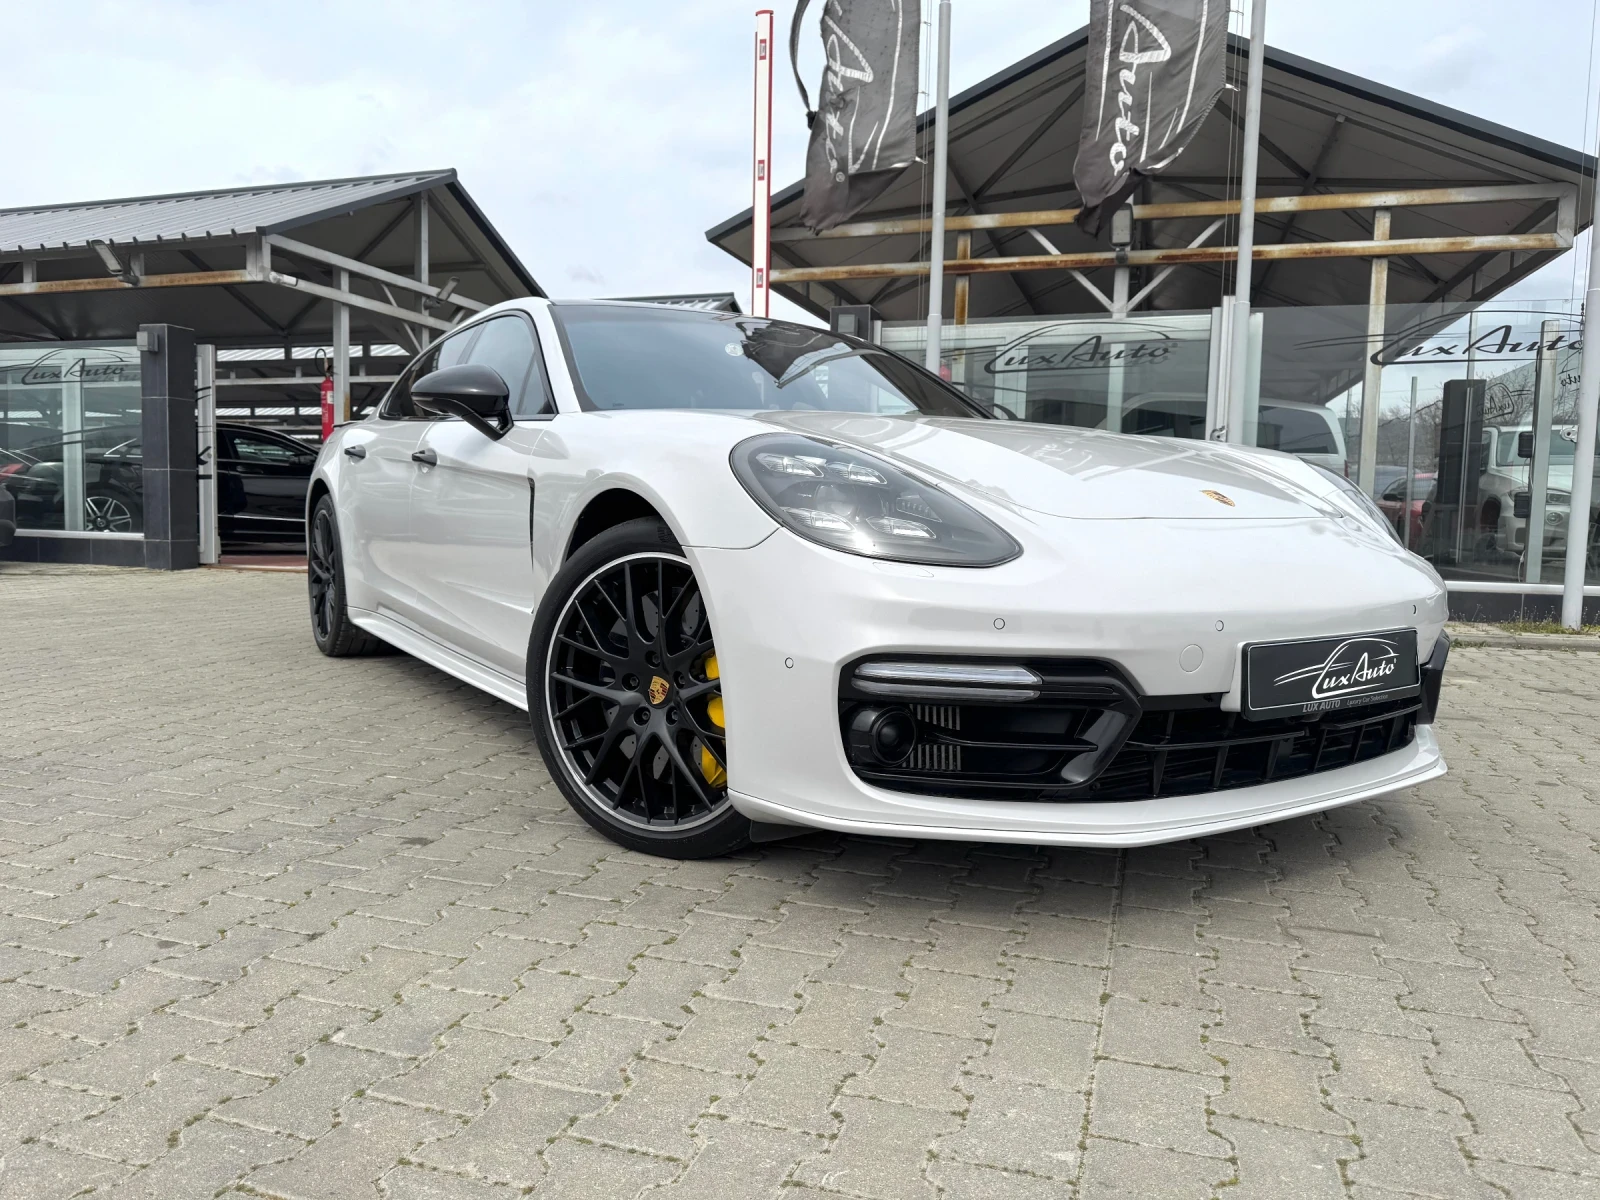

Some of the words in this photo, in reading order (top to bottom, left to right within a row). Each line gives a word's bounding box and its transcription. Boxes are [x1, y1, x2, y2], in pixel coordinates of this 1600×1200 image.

[1110, 4, 1171, 176] Auto
[1351, 652, 1395, 684] Auto
[1302, 702, 1320, 712] LUX
[1320, 700, 1340, 710] AUTO
